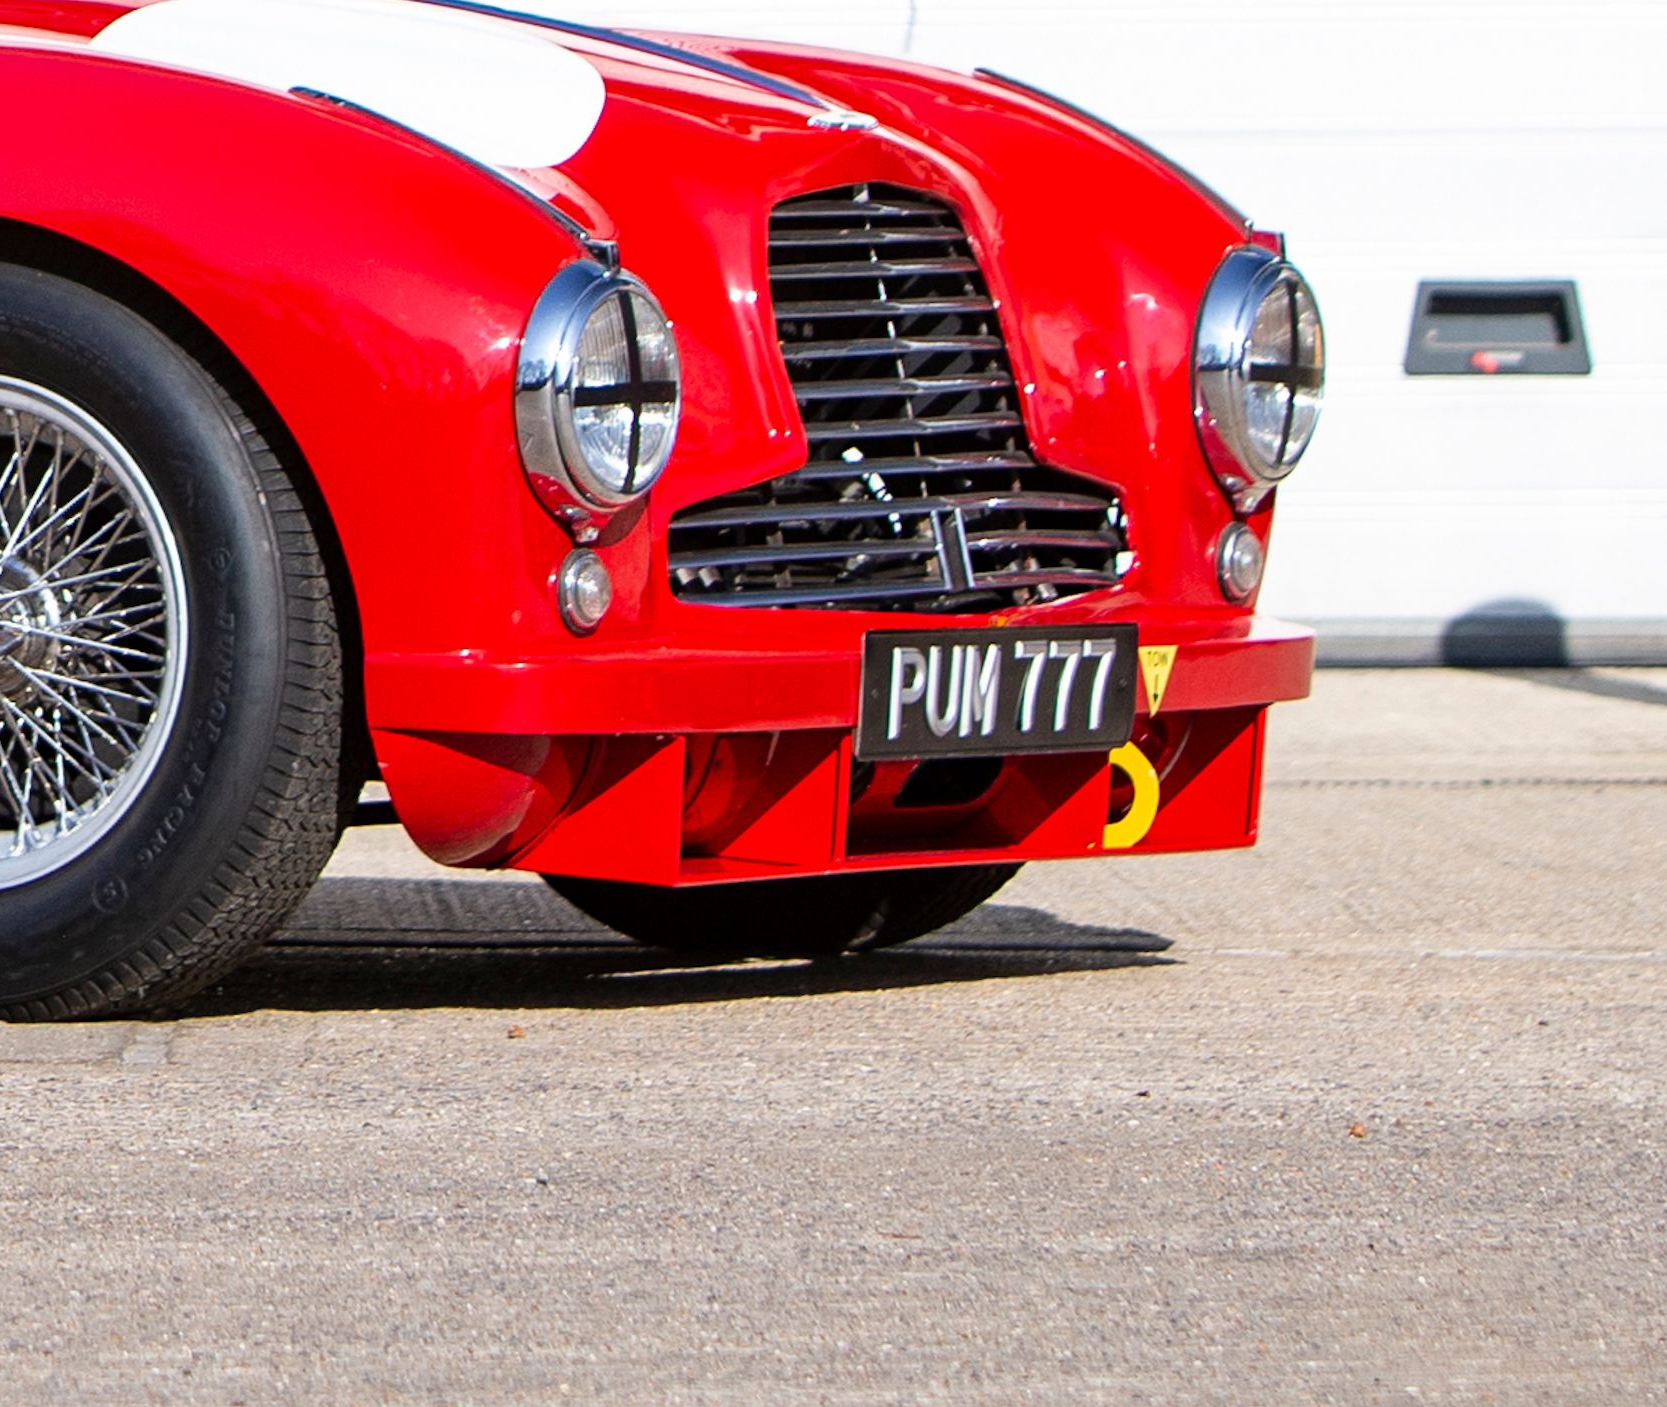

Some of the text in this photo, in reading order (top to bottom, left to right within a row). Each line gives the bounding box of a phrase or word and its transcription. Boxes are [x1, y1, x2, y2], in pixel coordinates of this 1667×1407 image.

[205, 610, 236, 743] DUNLOP
[888, 638, 1116, 740] PUM 777
[135, 760, 207, 866] RACING
